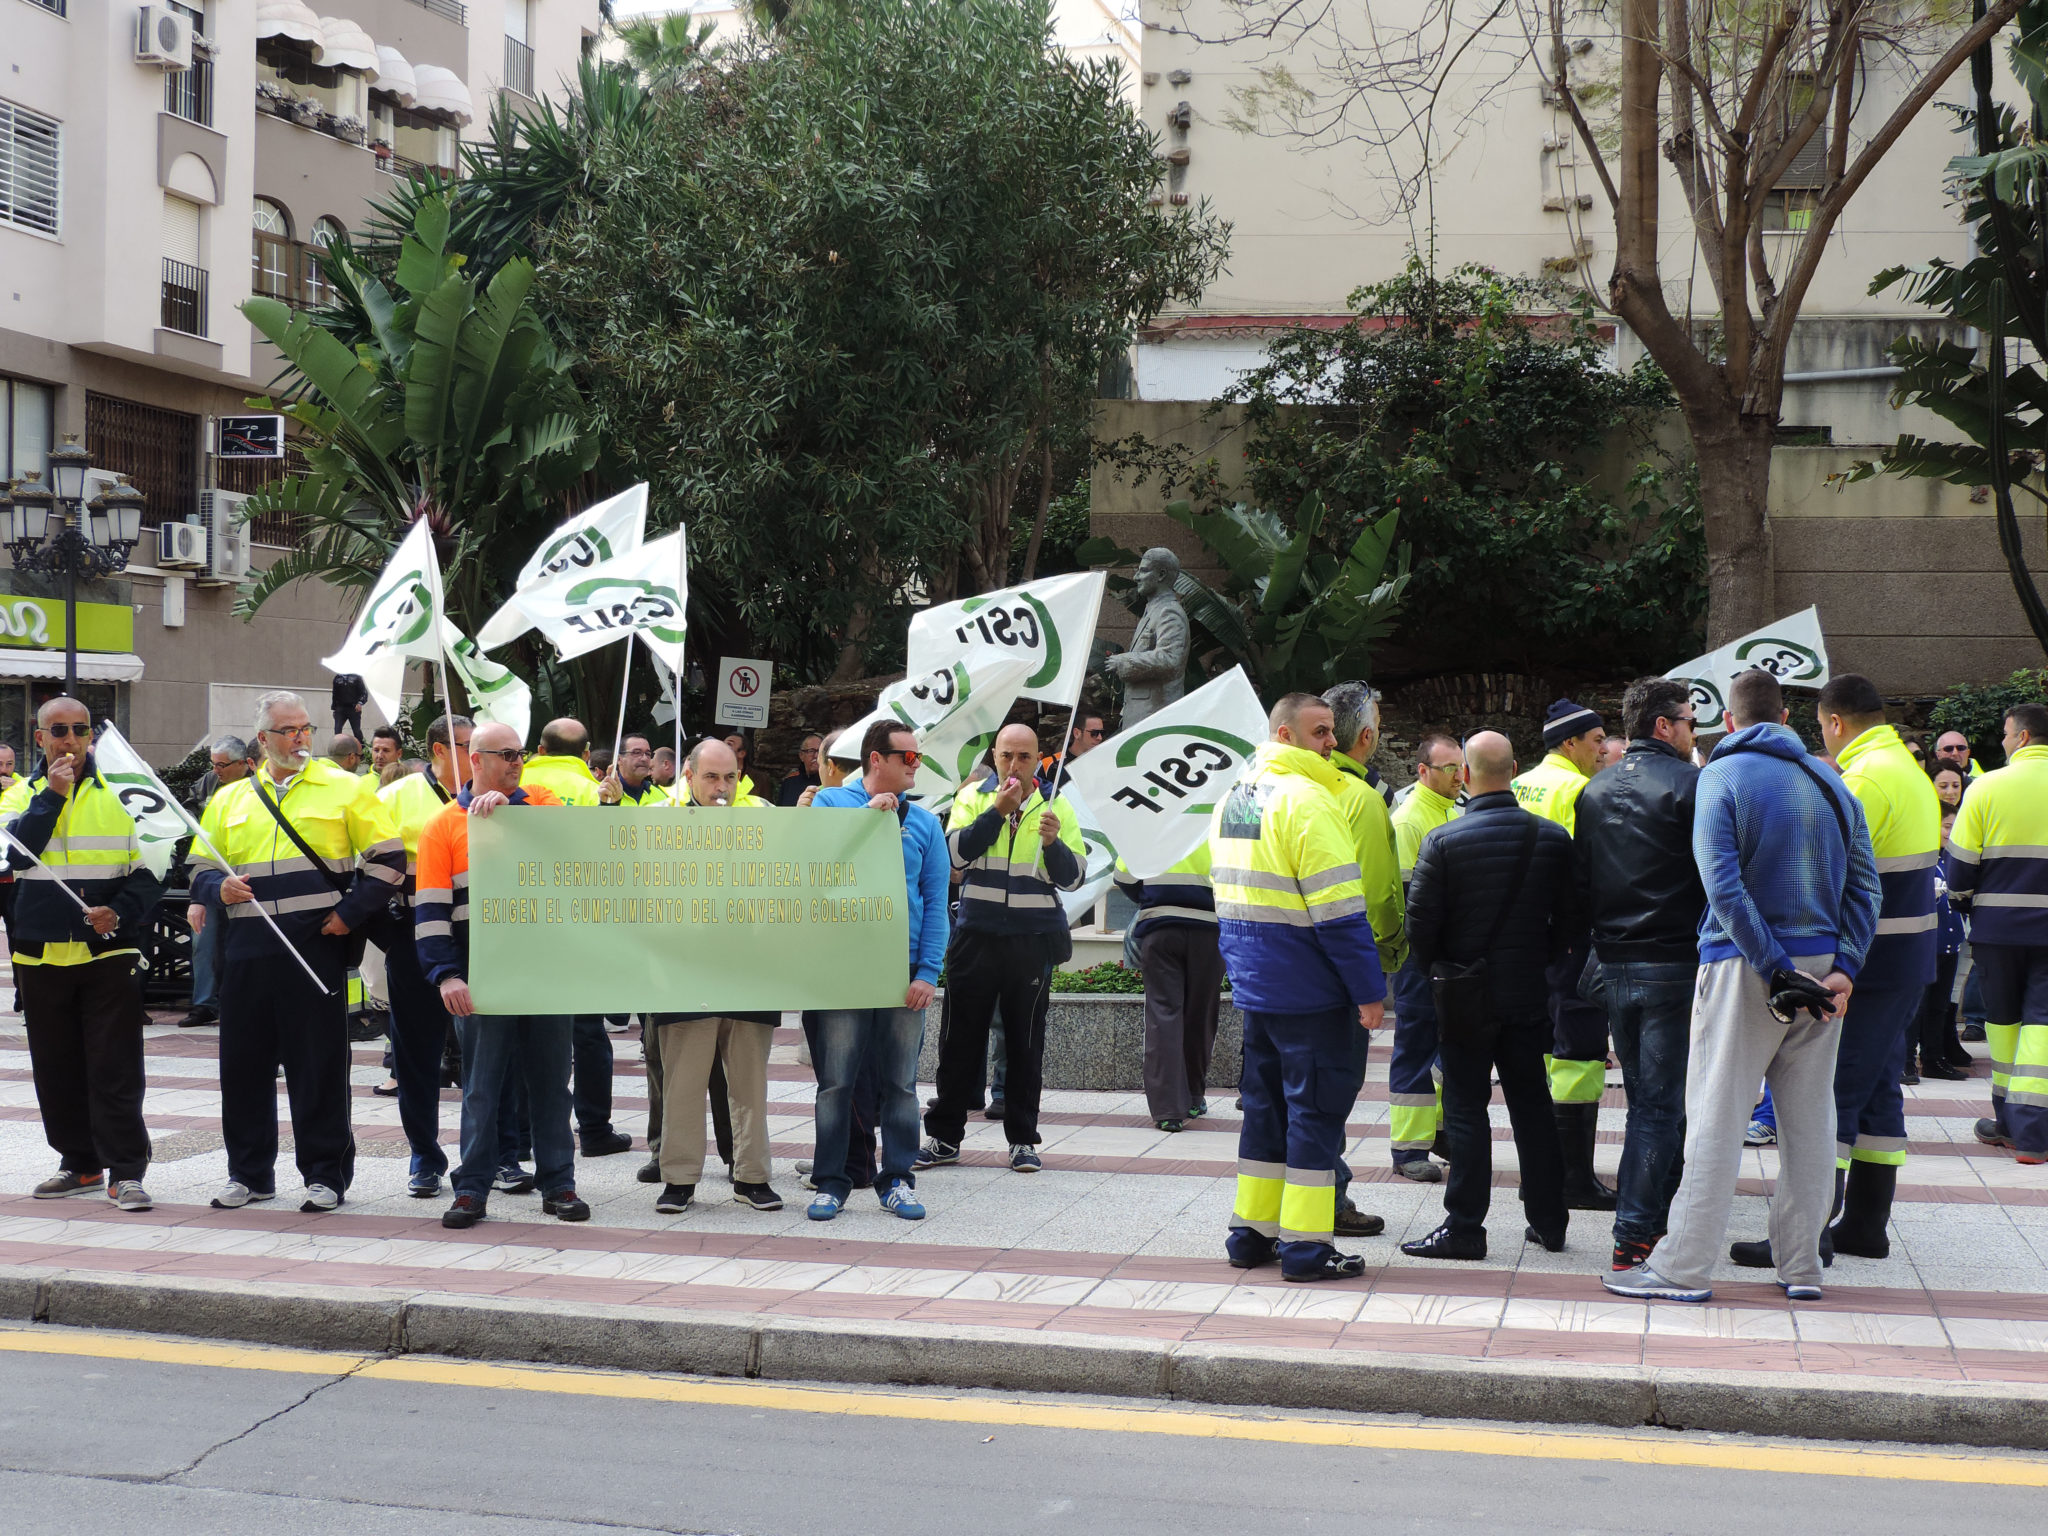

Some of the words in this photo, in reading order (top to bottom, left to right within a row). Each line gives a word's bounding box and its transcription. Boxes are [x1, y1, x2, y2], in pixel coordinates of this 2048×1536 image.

[609, 825, 638, 850] LOS
[645, 825, 764, 851] TRABAJADORES
[518, 861, 546, 887] DEL
[554, 861, 625, 887] SERVICIO
[633, 861, 698, 887] PUBLICO
[706, 862, 725, 887] DE
[732, 861, 802, 887] LIMPIEZA
[808, 861, 858, 887] VIARIA
[482, 898, 538, 924] EXIGEN
[546, 898, 564, 924] EL
[571, 898, 684, 924] CUMPLIMIENTO
[691, 898, 719, 924] DEL
[727, 898, 803, 924] CONVENIO
[810, 896, 894, 924] COLECTIVO
